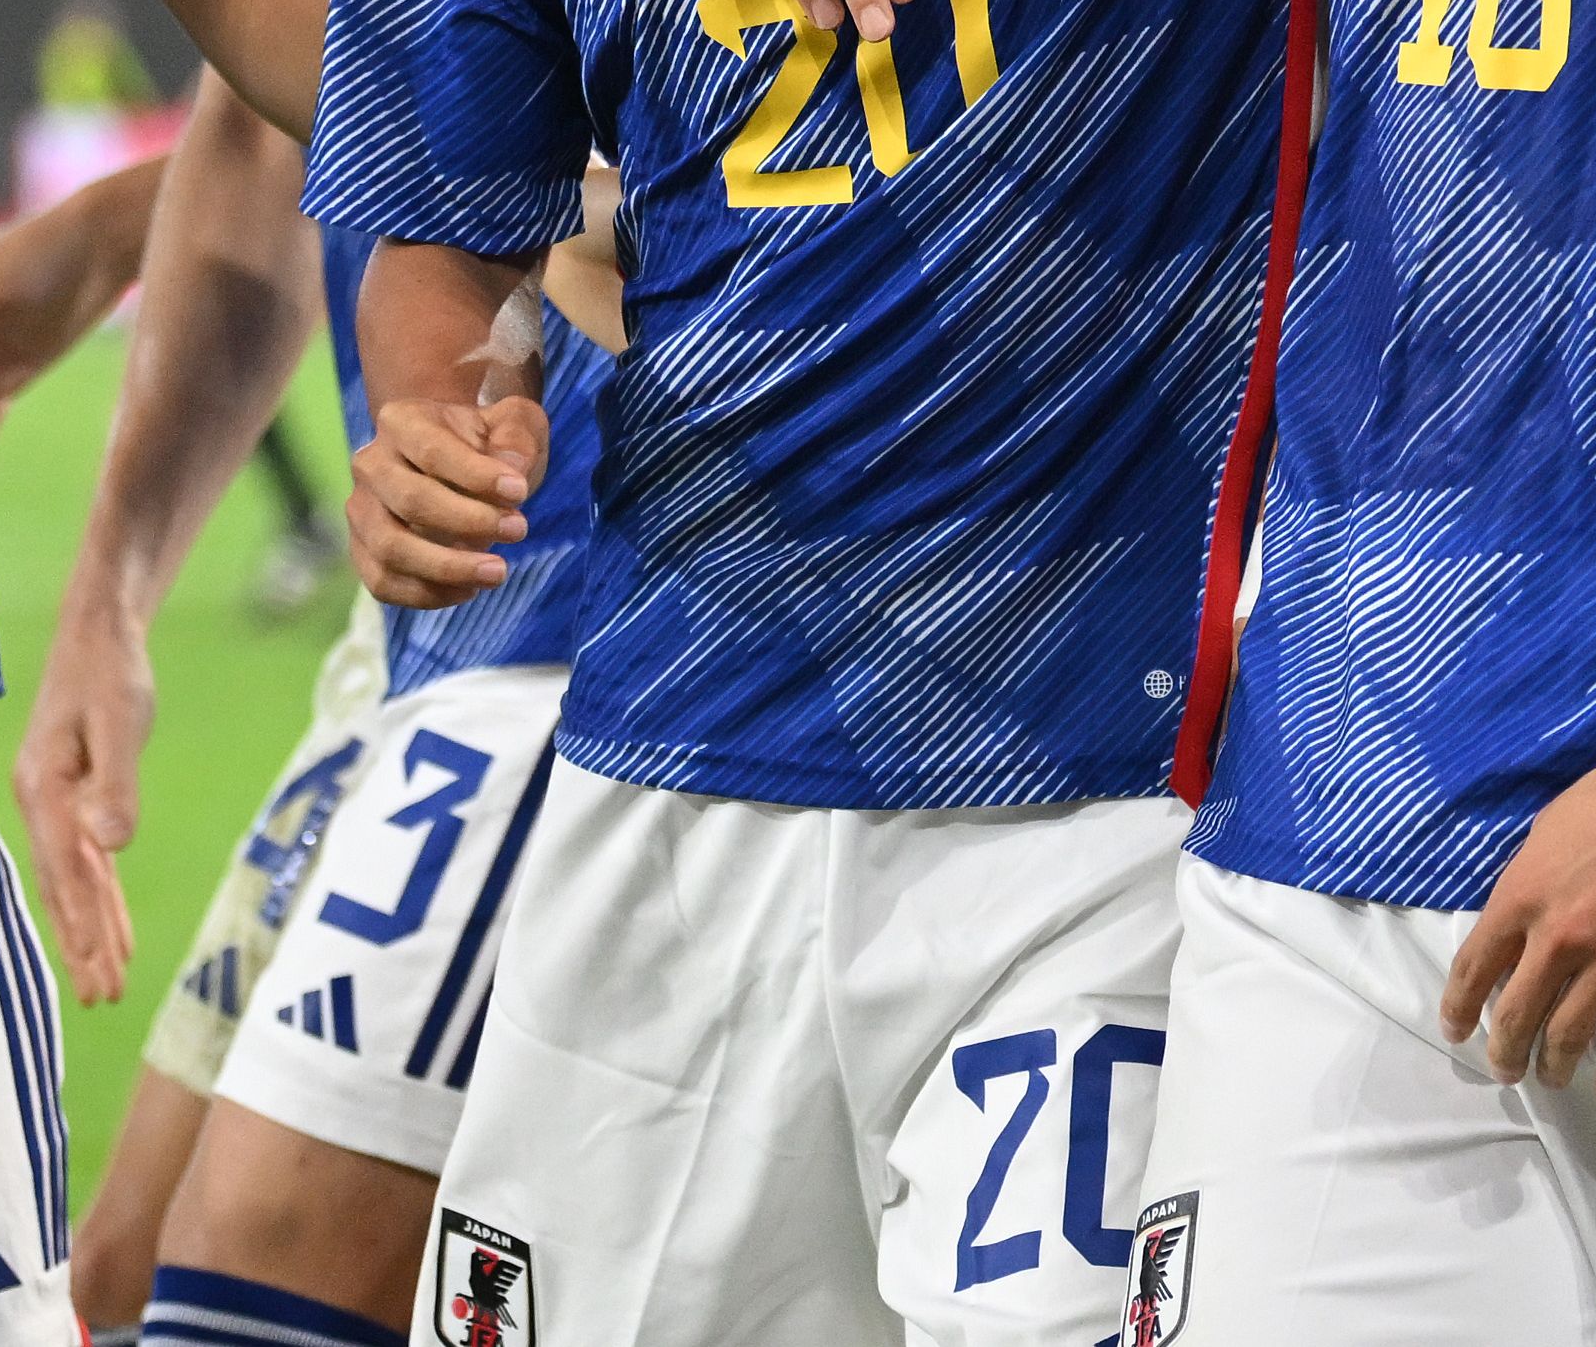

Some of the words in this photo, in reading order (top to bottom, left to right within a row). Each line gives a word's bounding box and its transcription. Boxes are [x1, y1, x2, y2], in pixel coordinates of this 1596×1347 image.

[317, 727, 495, 947] 3
[1140, 1199, 1178, 1229] JAPAN
[463, 1219, 512, 1250] JAPAN
